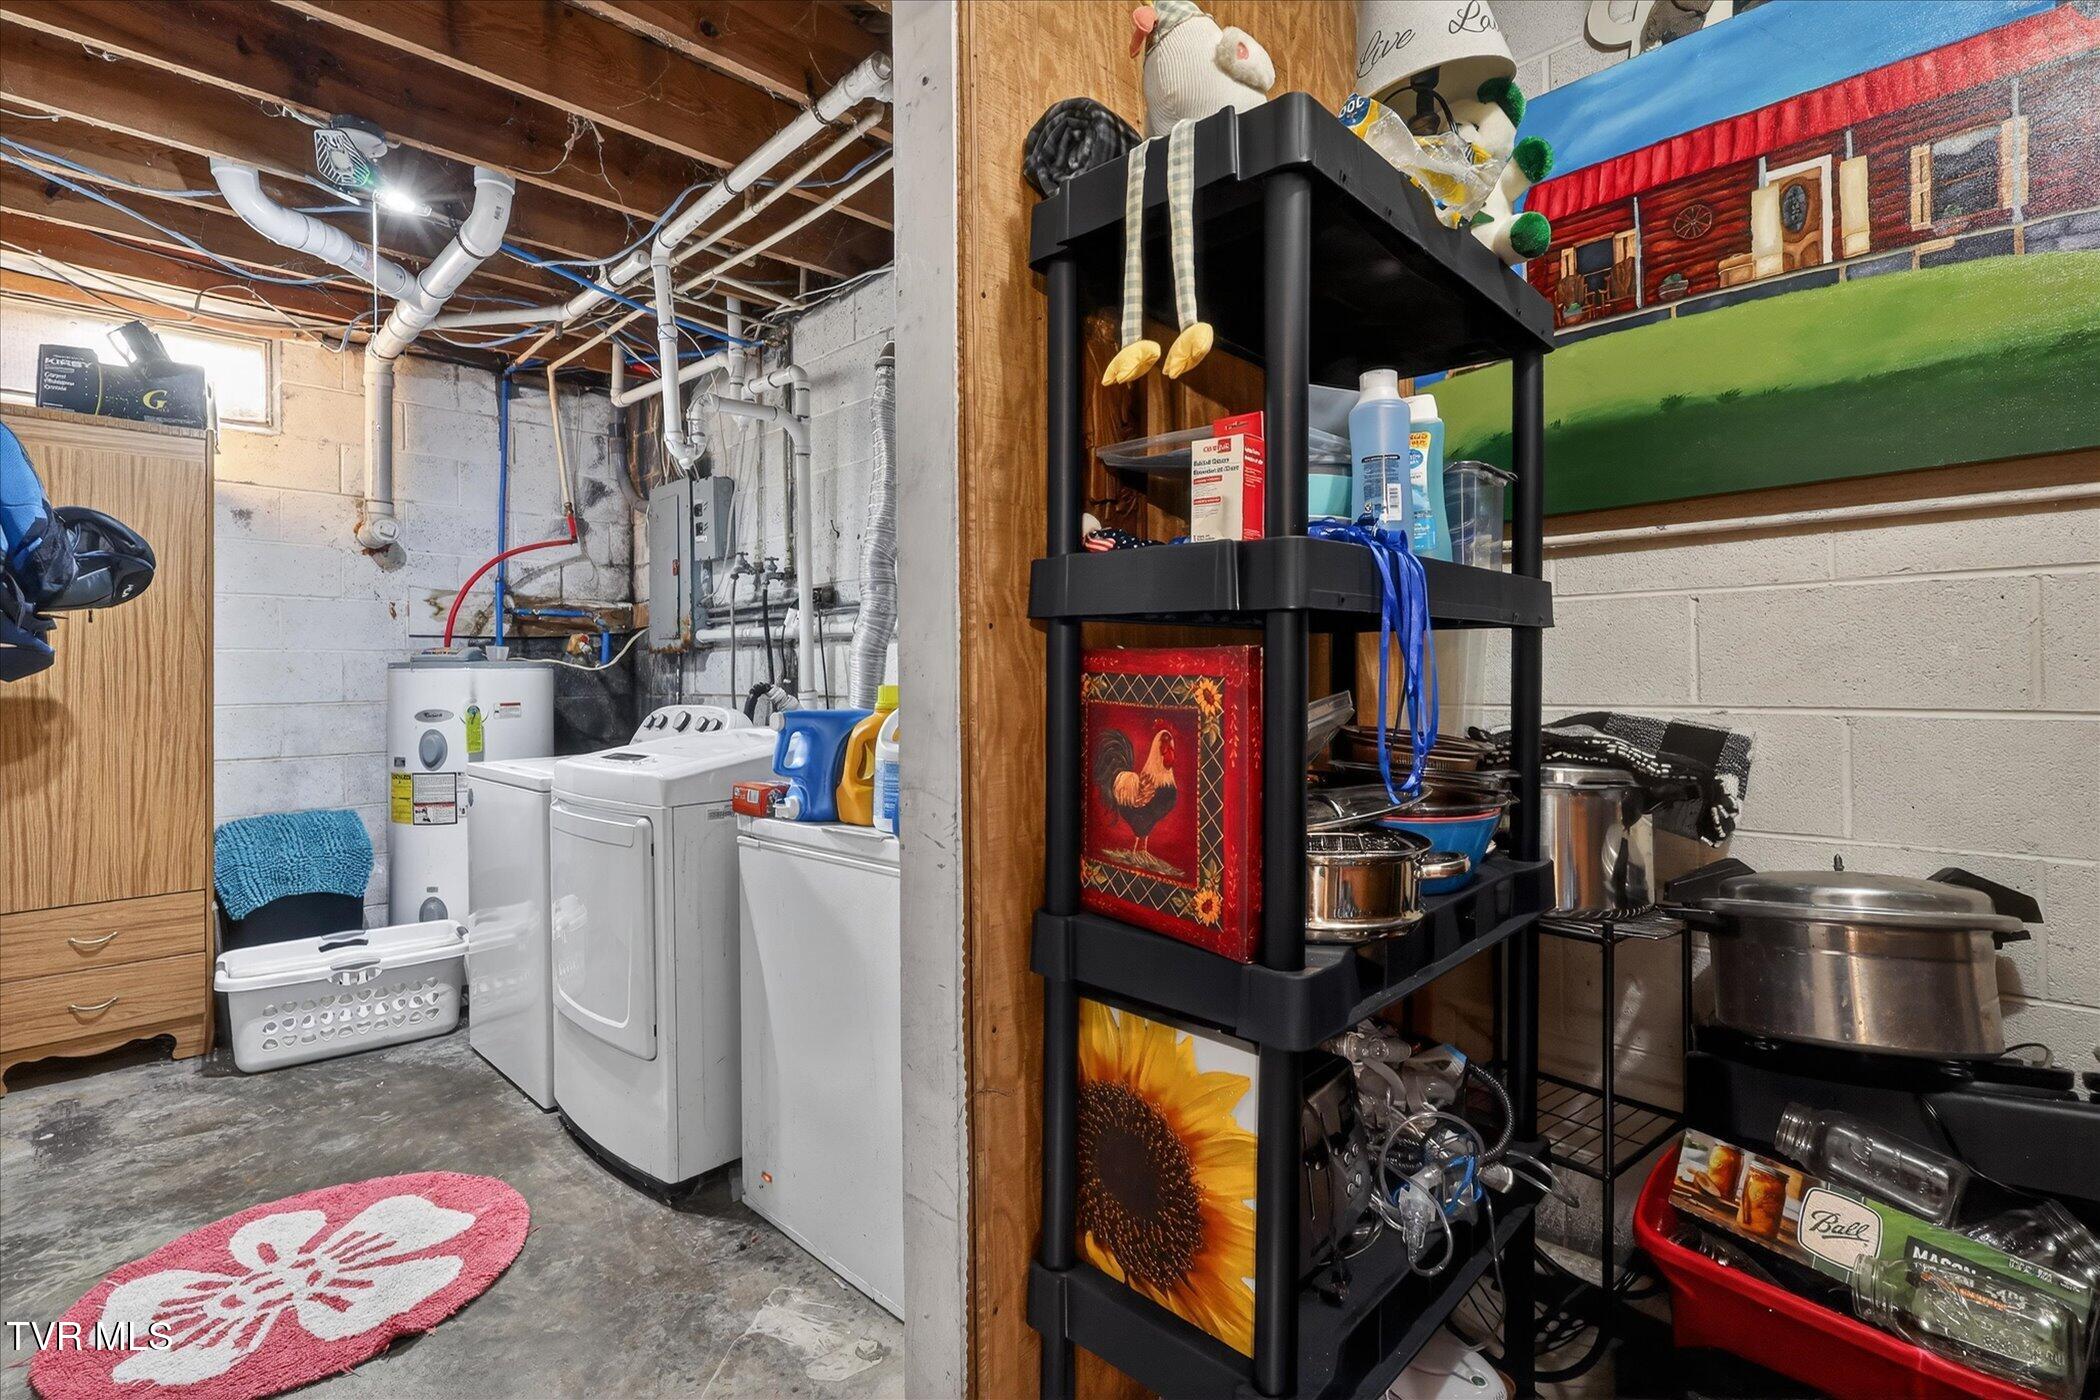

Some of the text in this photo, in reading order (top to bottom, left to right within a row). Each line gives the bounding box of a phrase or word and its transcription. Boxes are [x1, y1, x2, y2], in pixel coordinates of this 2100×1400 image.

[1449, 0, 1498, 34] La
[143, 389, 168, 410] G
[1809, 1210, 1870, 1242] Ball
